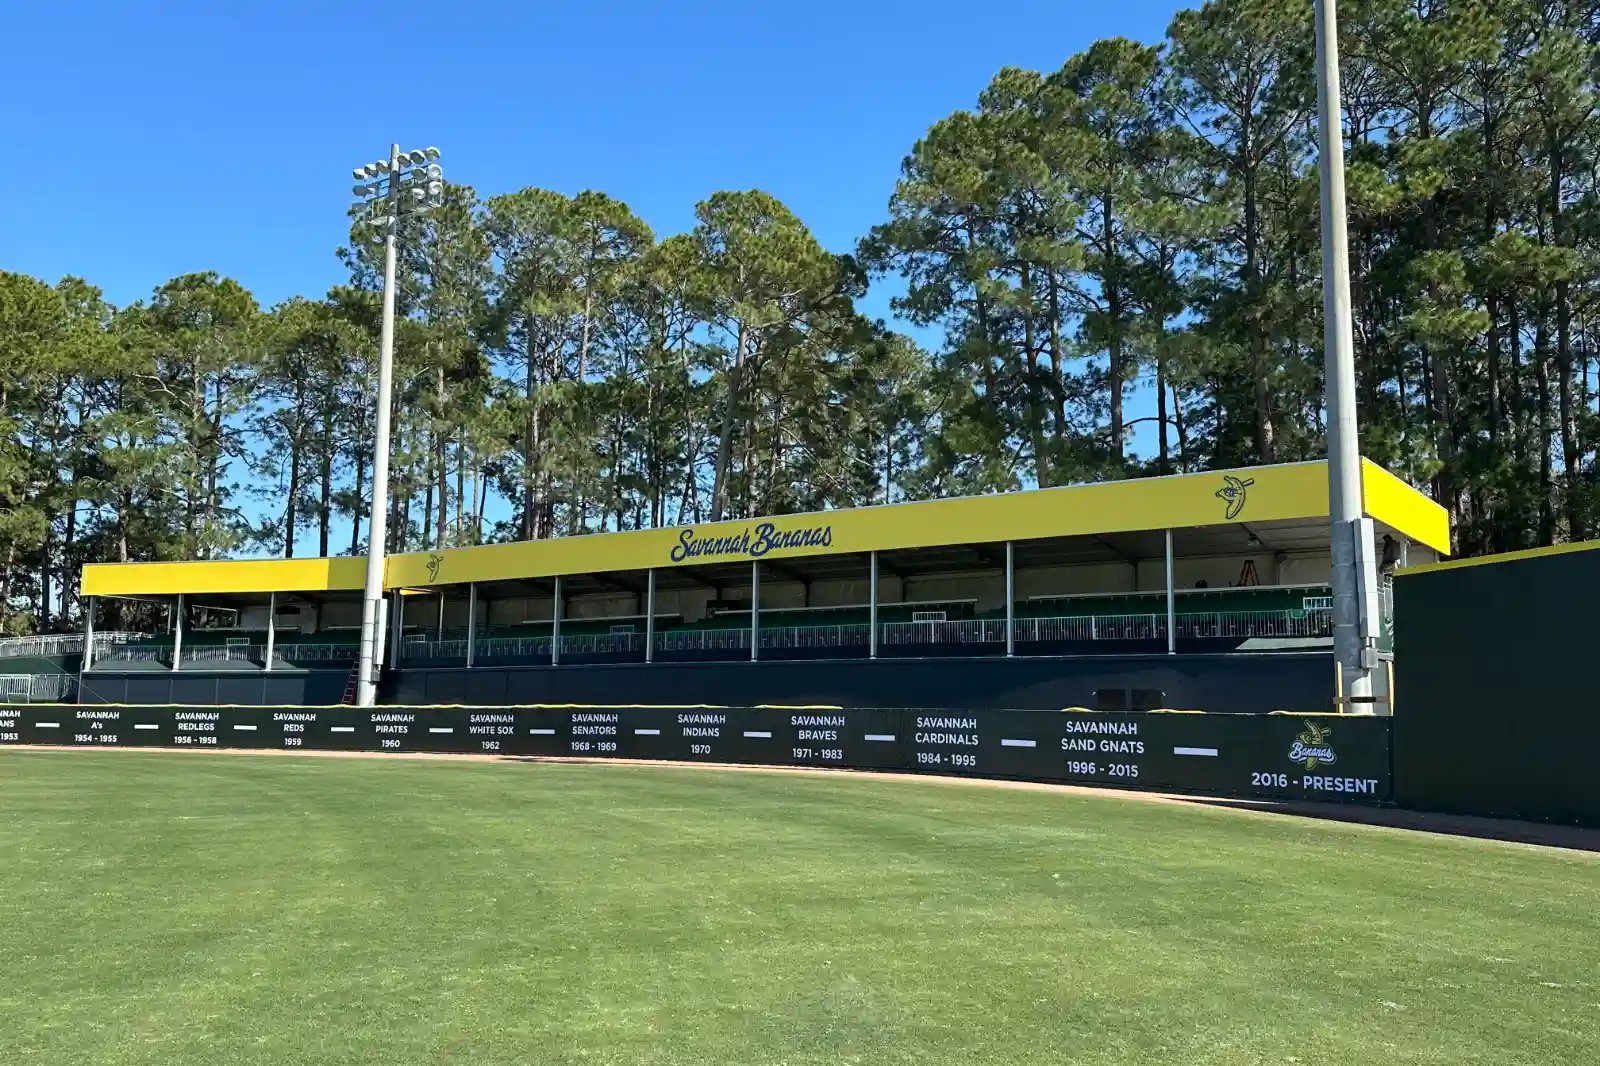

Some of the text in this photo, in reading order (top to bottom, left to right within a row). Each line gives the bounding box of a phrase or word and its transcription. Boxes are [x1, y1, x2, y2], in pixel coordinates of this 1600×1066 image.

[671, 529, 749, 562] Savannah
[76, 710, 120, 719] SAVANNAH
[174, 712, 219, 720] SAVANNAH
[273, 712, 317, 722] SAVANNAH
[370, 713, 415, 723] SAVANNAH
[470, 714, 514, 723] SAVANNAH
[572, 713, 618, 723] SAVANNAH
[678, 713, 726, 724] SAVANNAH
[91, 721, 103, 730] A's
[791, 715, 845, 726] SAVANNAH
[916, 716, 977, 729] SAVANNAH
[177, 722, 215, 731] REDLEGS
[283, 723, 305, 732] REDS
[375, 725, 409, 734] PIRATES
[469, 726, 514, 735] WHITE SOX
[572, 725, 617, 735] SENATORS
[1066, 720, 1138, 735] SAVANNAH
[0, 732, 19, 741] 1953
[682, 726, 720, 738] INDIANS
[798, 730, 838, 741] BRAVES
[74, 734, 93, 742] 1954
[100, 734, 118, 743] 1955
[174, 736, 192, 744] 1956
[199, 736, 217, 745] 1958
[284, 737, 302, 746] 1959
[381, 739, 401, 748] 1960
[915, 732, 979, 746] CARDINALS
[481, 741, 500, 750] 1962
[571, 741, 590, 750] 1968
[597, 742, 617, 751] 1969
[690, 744, 711, 755] 1970
[1061, 738, 1145, 754] SAND GNATS
[792, 748, 812, 758] 1971
[821, 749, 843, 760] 1983
[1289, 741, 1335, 763] Bananas
[916, 752, 941, 764] 1984
[951, 753, 977, 767] 1995
[1067, 761, 1096, 775] 1996
[1108, 763, 1139, 778] 2015
[1251, 772, 1288, 788] 2016
[1303, 775, 1379, 794] PRESENT
